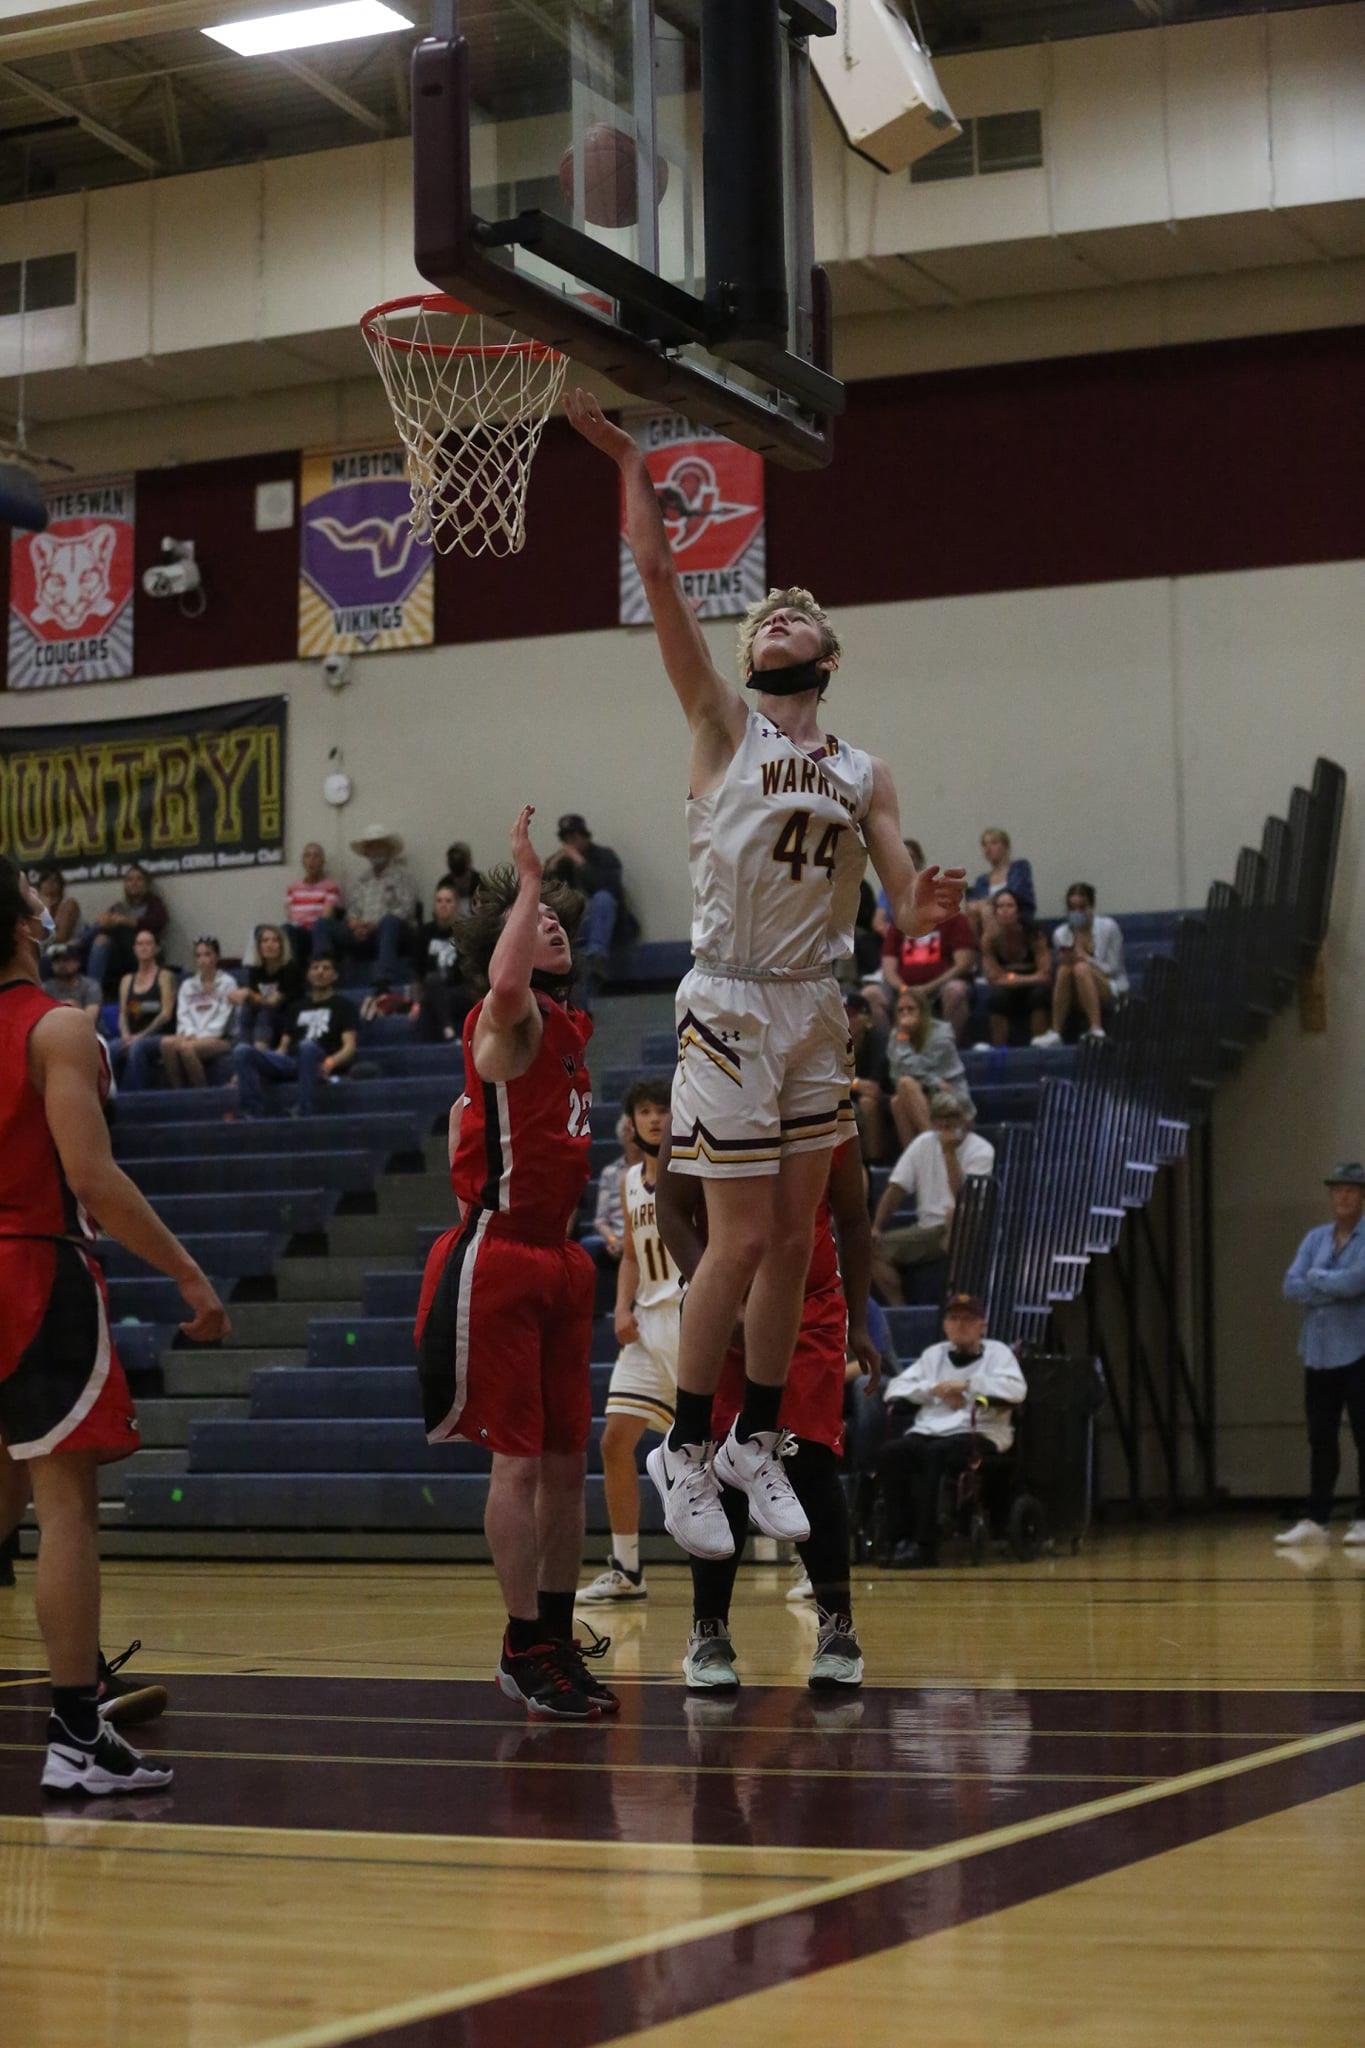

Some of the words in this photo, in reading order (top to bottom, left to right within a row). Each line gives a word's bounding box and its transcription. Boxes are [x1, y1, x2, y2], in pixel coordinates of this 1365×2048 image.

[651, 415, 720, 446] GRAN
[332, 452, 405, 478] MABTON
[682, 570, 742, 595] RTANS
[335, 606, 403, 634] VIKINGS
[35, 638, 109, 667] COUGARS
[0, 725, 280, 862] UNTRY!
[773, 810, 850, 881] 44
[567, 1088, 593, 1137] 22
[644, 1238, 670, 1281] 11
